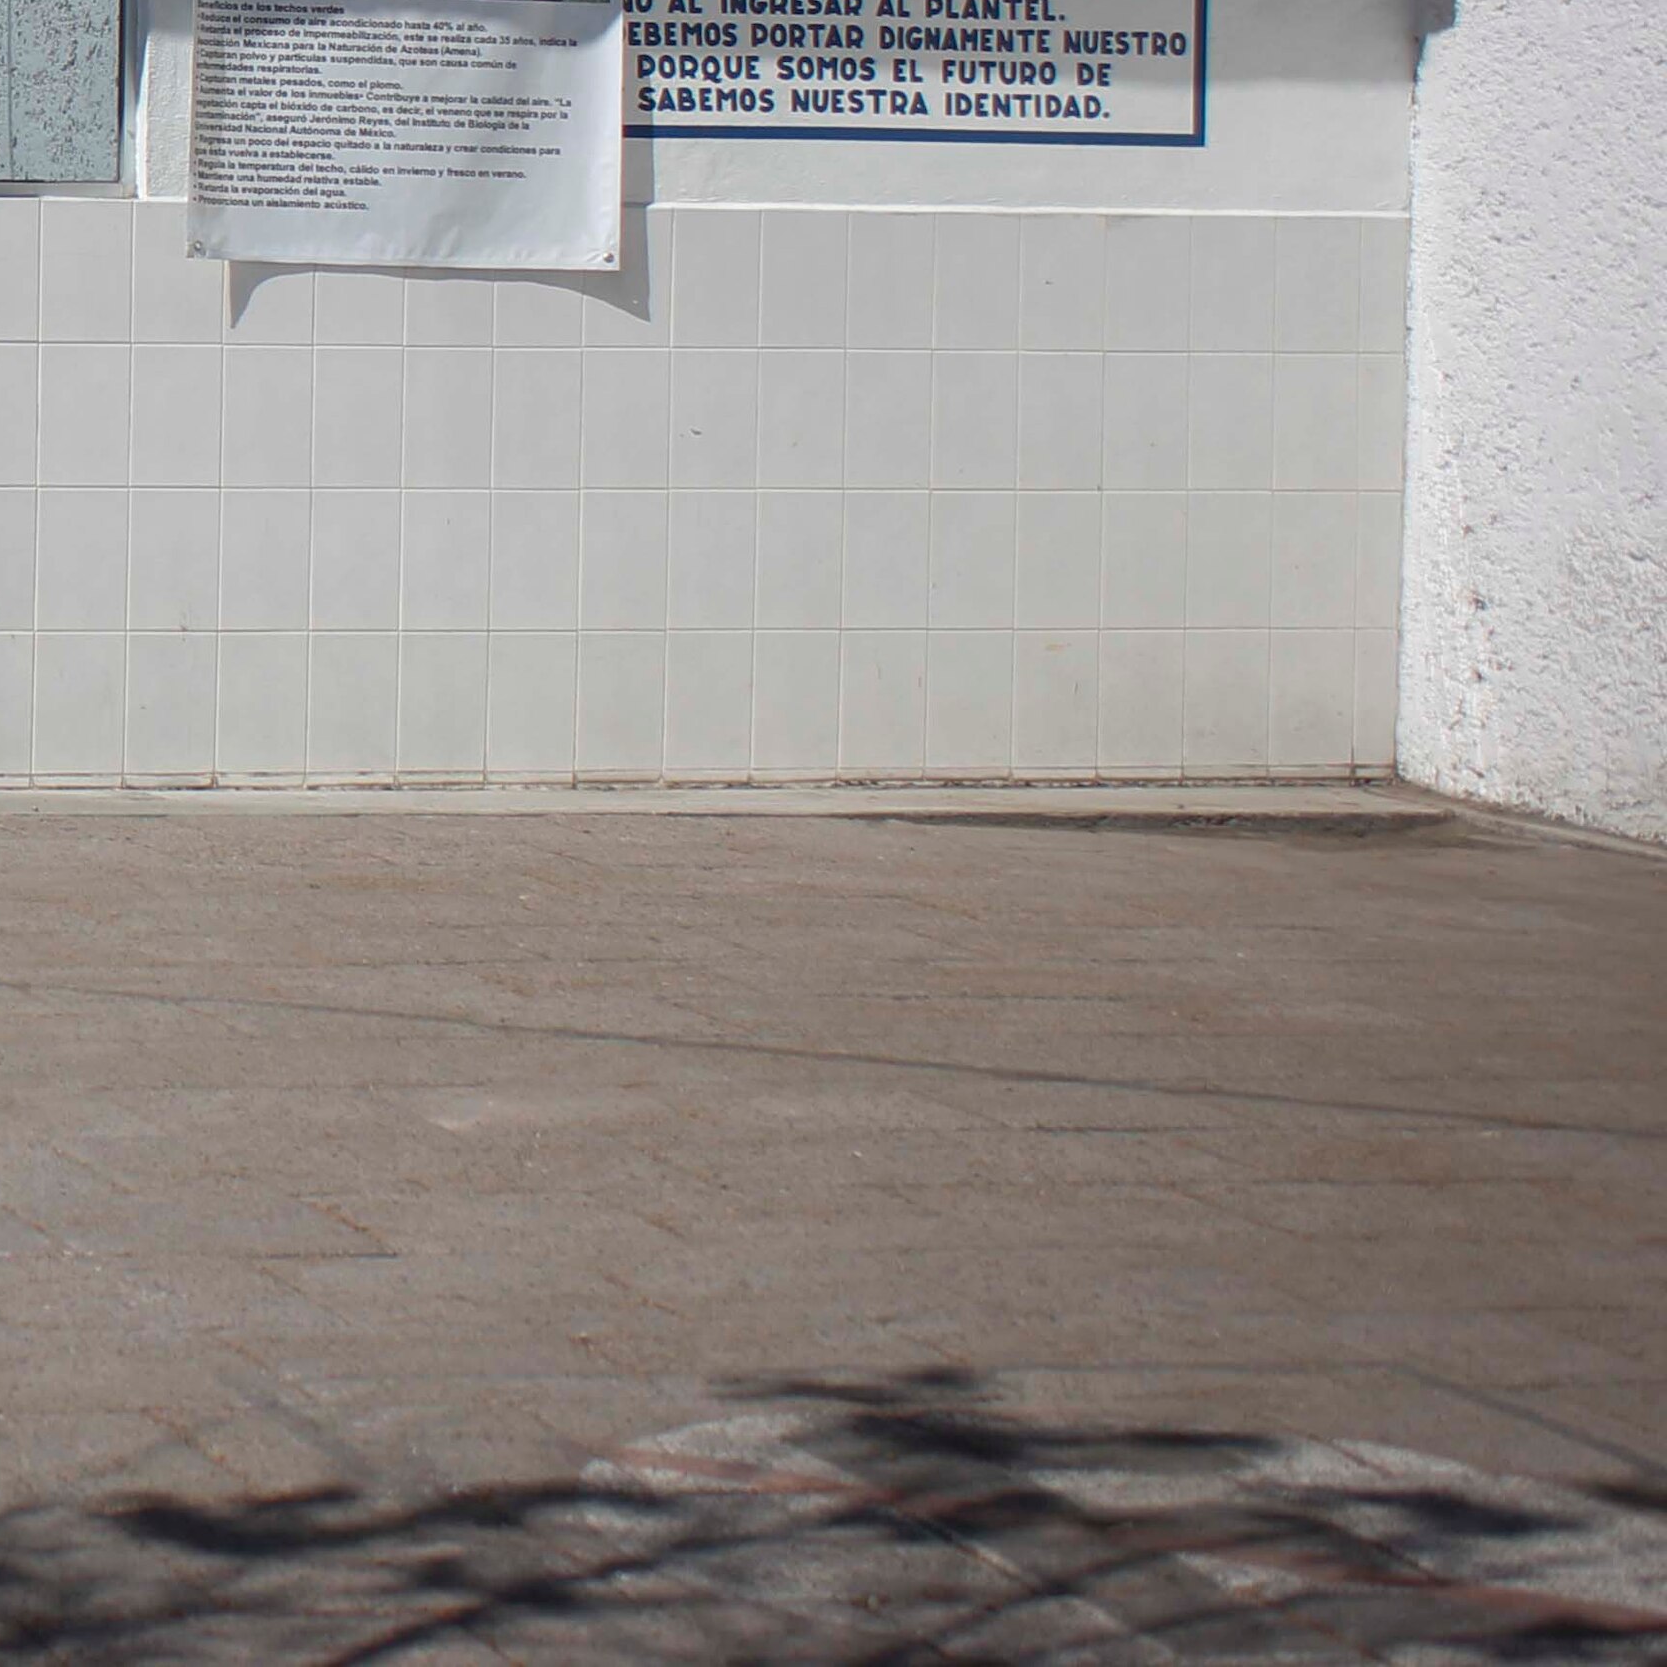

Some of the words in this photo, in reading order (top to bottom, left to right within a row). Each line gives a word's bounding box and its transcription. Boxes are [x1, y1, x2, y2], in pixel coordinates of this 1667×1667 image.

[628, 21, 738, 48] EBEMOS
[751, 22, 865, 49] PORTAR
[879, 25, 1051, 54] DIGNAMENTE
[1064, 30, 1188, 56] NUESTRO
[636, 53, 761, 84] PORQUE
[777, 56, 878, 82] SOMOS
[892, 58, 924, 83] EL
[942, 59, 1059, 86] FUTURO
[1077, 62, 1112, 87] DE
[637, 85, 776, 117] SABEMOS
[791, 88, 929, 116] NUESTRA
[946, 92, 1110, 119] IDENTIDAD.
